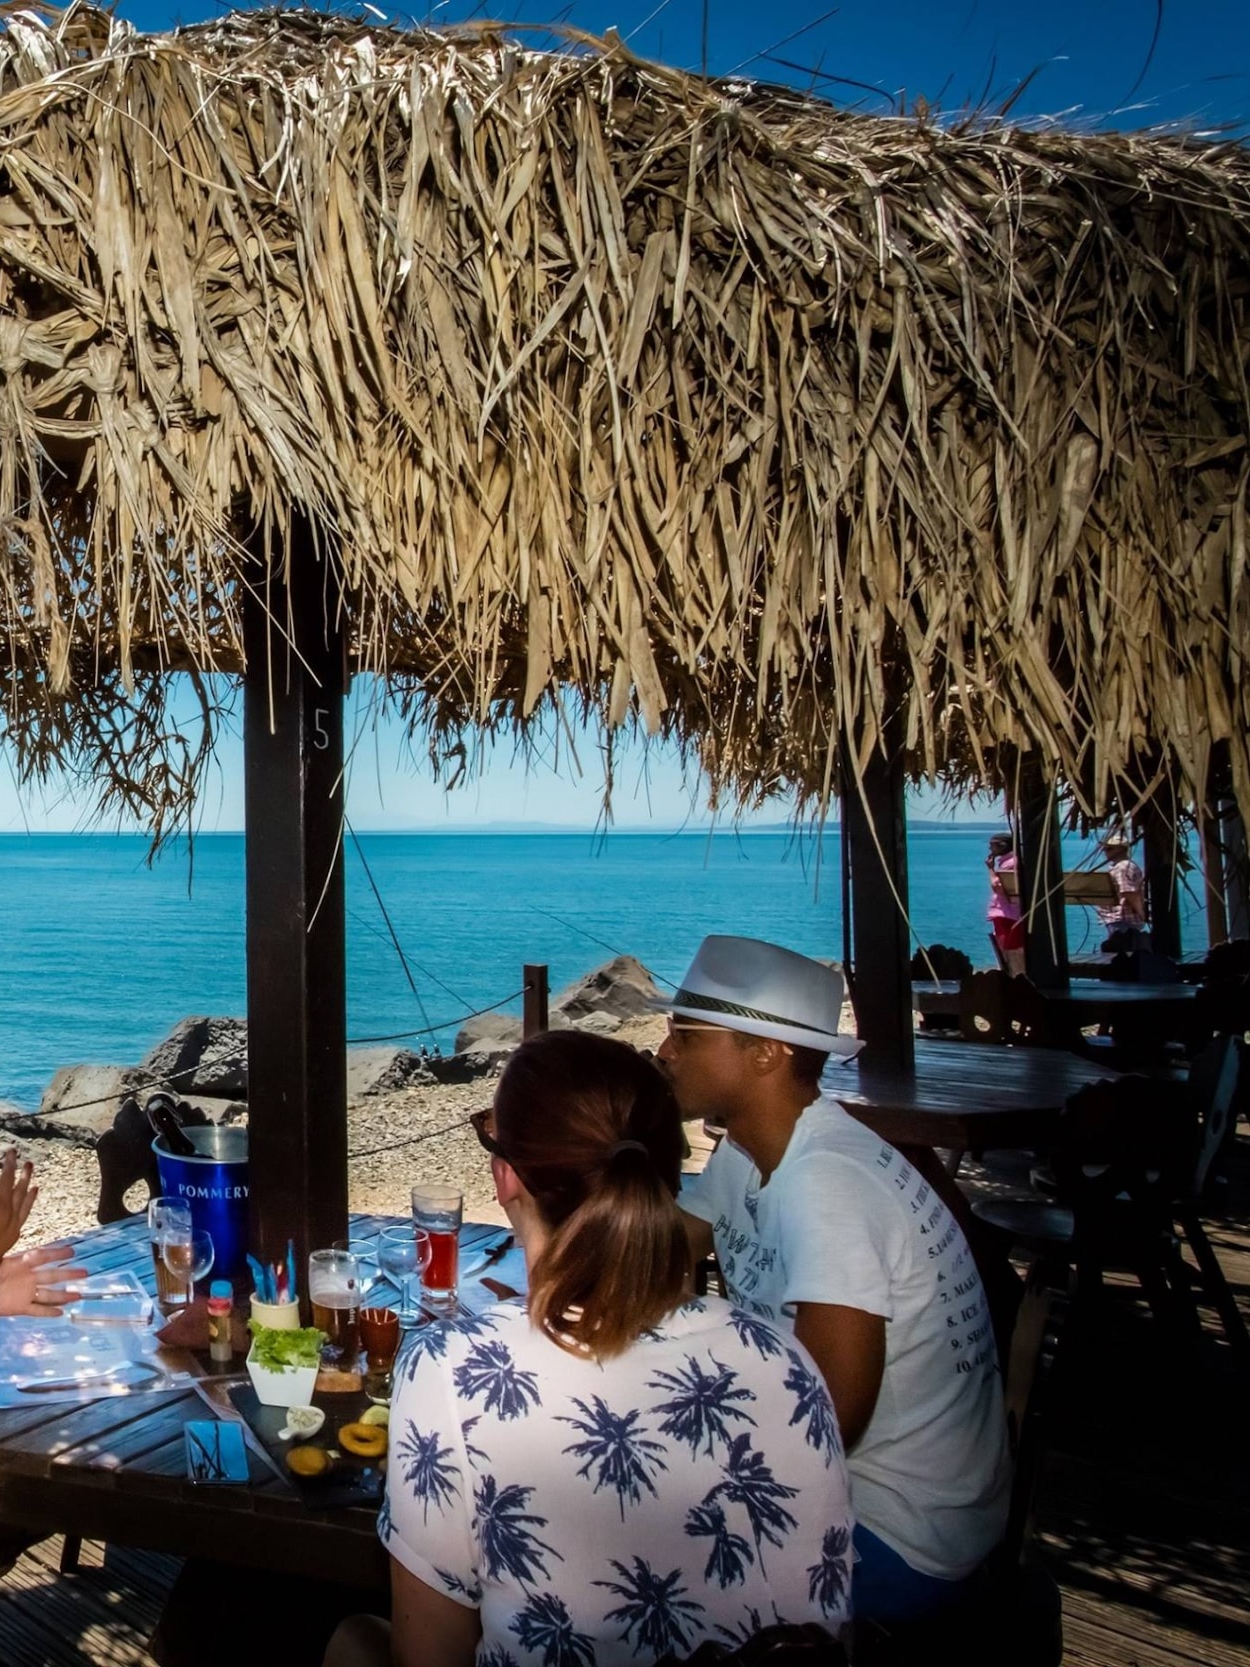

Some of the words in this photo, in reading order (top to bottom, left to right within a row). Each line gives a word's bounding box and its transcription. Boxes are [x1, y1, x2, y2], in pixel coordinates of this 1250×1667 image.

[313, 708, 330, 750] 5
[178, 1183, 249, 1200] POMMERY
[920, 1223, 931, 1236] 4.
[940, 1292, 953, 1305] 7.
[946, 1315, 959, 1329] 8.
[950, 1338, 963, 1352] 9.
